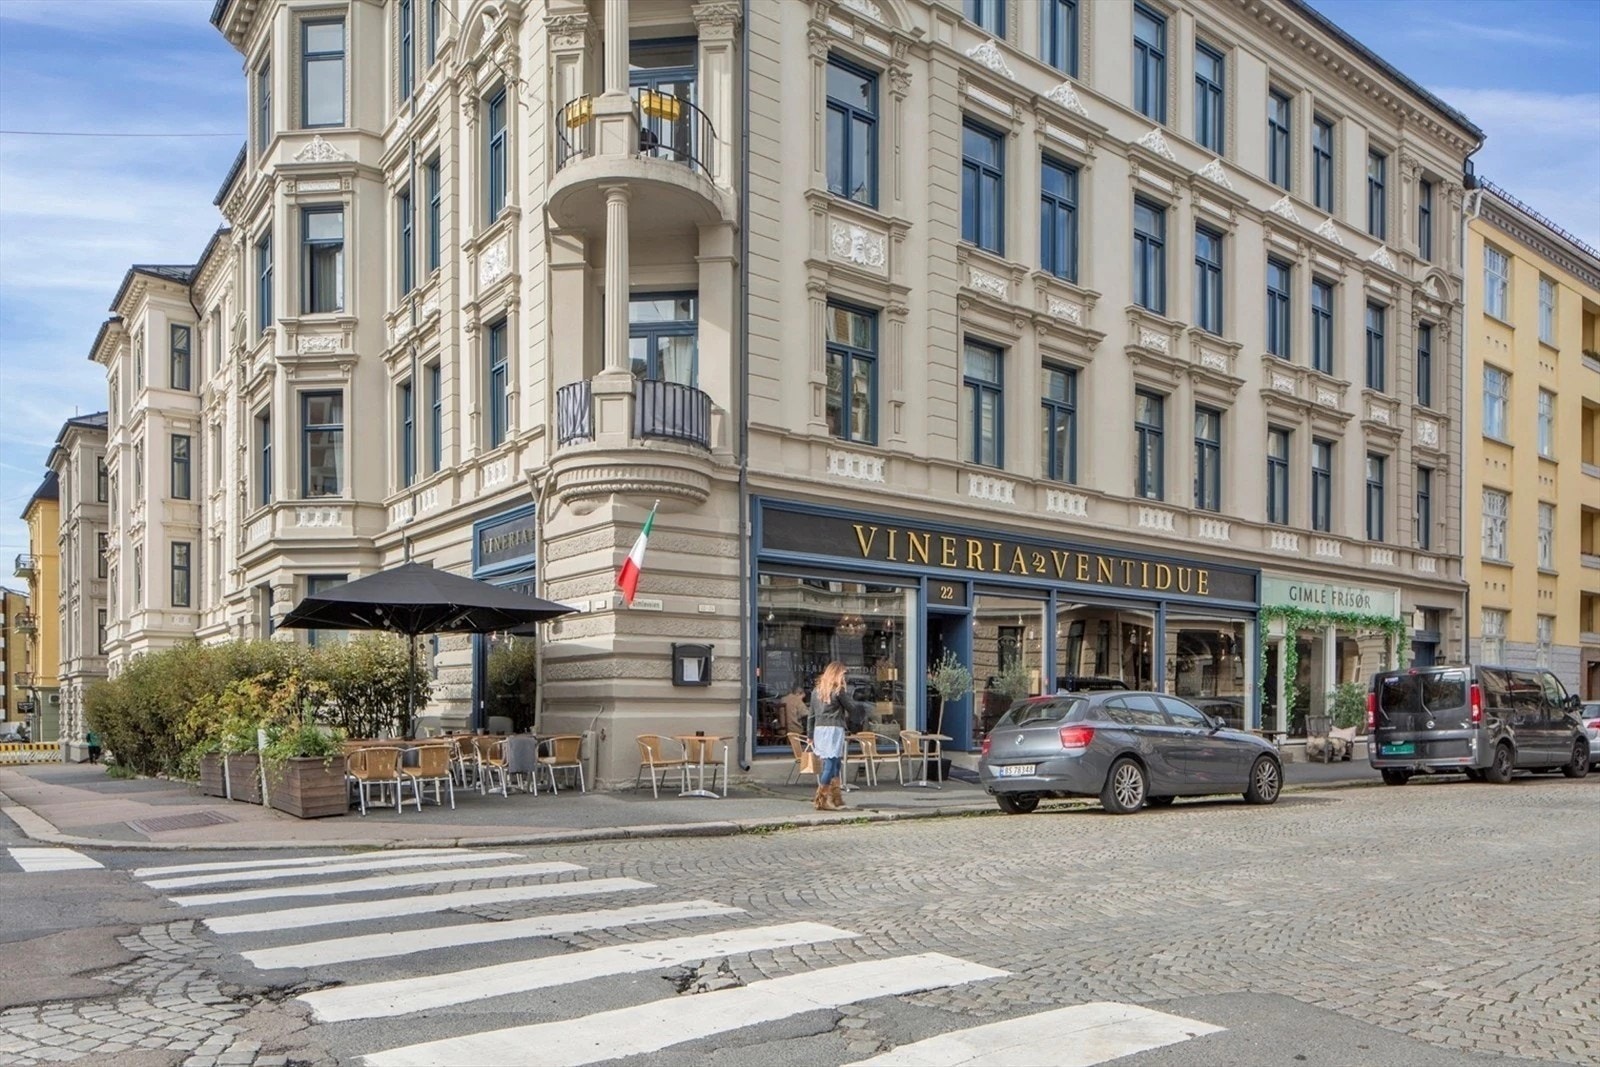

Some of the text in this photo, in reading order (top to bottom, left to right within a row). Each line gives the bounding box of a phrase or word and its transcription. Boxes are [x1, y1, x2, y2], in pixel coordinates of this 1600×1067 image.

[482, 528, 530, 555] VINERIA
[853, 524, 1029, 575] VINERIA
[1051, 550, 1209, 595] VENTIDUE
[940, 585, 953, 600] 22
[1289, 586, 1371, 609] GIMLE FRISØR
